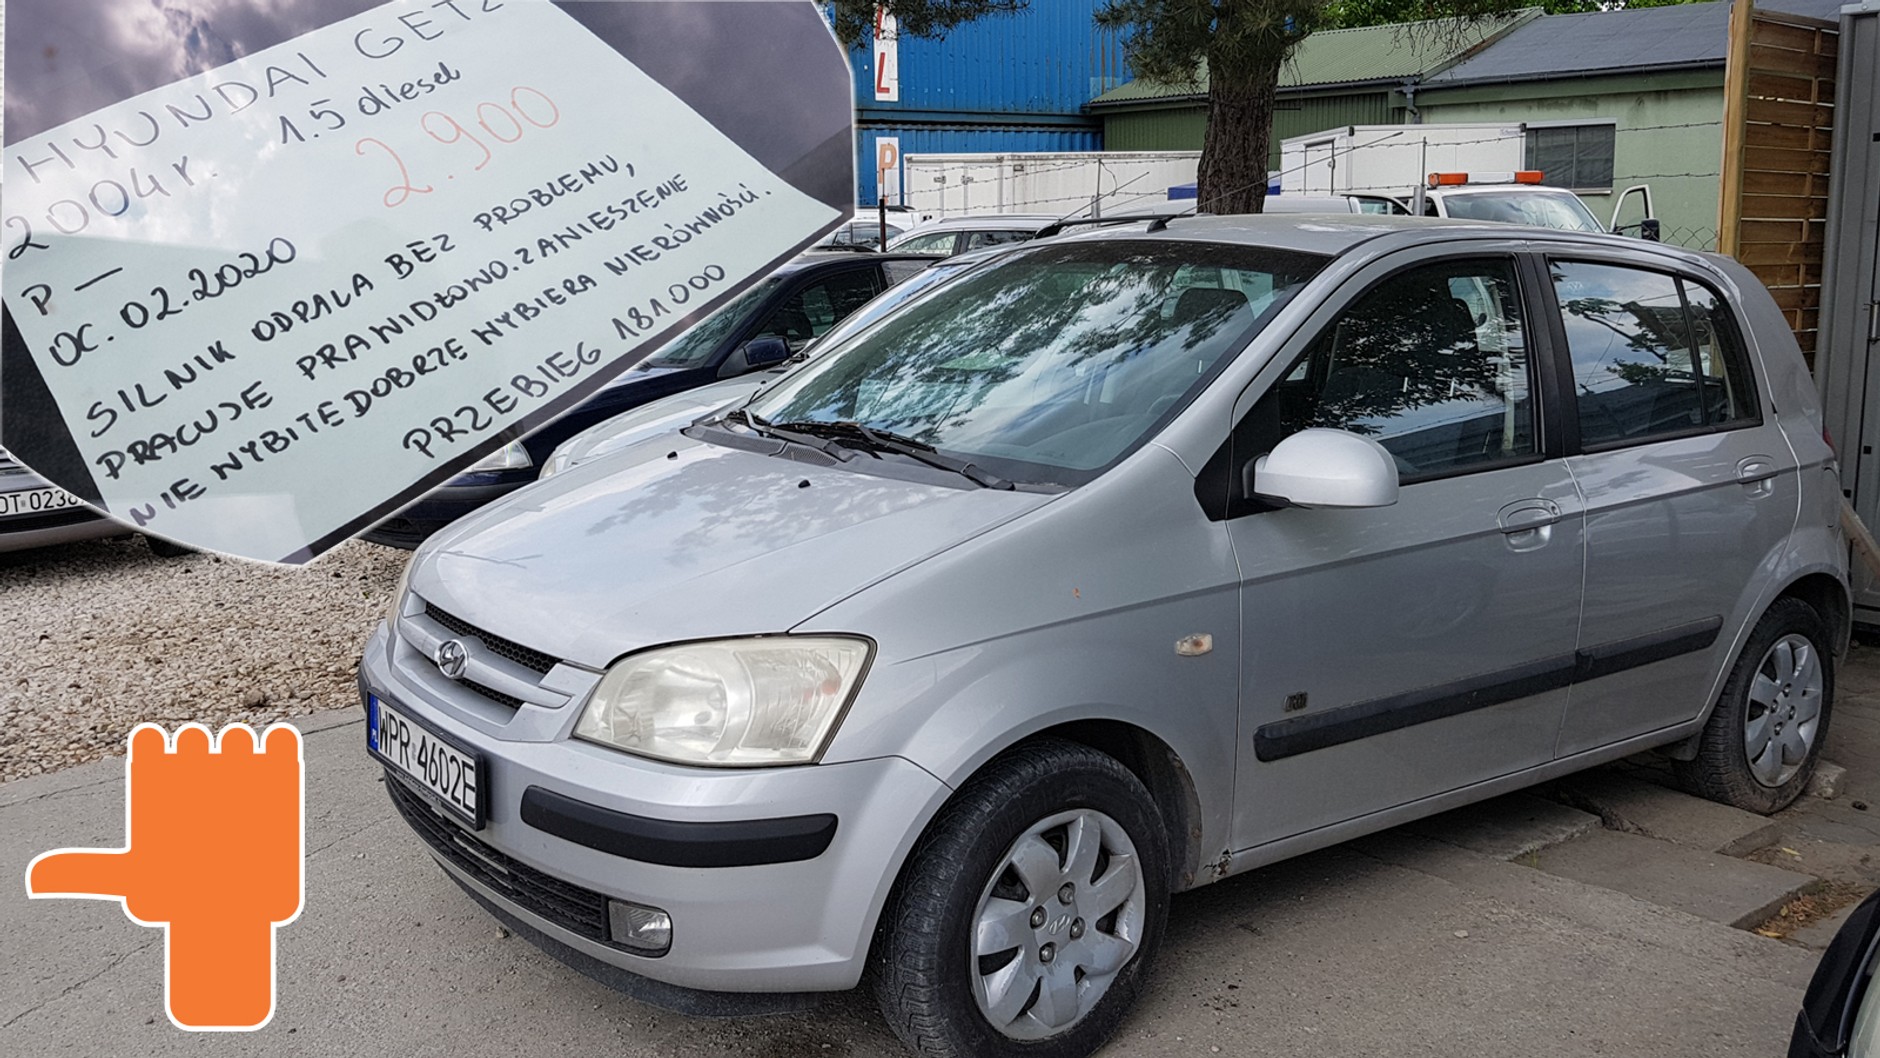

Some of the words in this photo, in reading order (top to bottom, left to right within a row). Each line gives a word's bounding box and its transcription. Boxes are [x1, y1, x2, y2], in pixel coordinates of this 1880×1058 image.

[16, 51, 327, 183] HYUNDAI
[279, 98, 347, 145] 1.5
[357, 61, 461, 117] diesel
[876, 52, 890, 93] L
[355, 86, 560, 208] 2.900
[878, 143, 897, 184] P
[21, 284, 52, 316] P
[48, 322, 115, 367] OC.
[119, 237, 297, 329] 02.2020
[85, 340, 236, 438] SILNIK
[251, 272, 374, 341] ODPALA
[384, 234, 455, 280] BEZ
[473, 154, 635, 233] PROBLEMU,
[96, 380, 273, 479] PRACUJE
[129, 477, 208, 526] NIE
[344, 337, 469, 418] DOBRZE
[471, 274, 597, 346] WYBIERA
[402, 341, 602, 459] PRZEBIEG
[379, 705, 411, 770] WPR
[417, 735, 476, 815] 4602E
